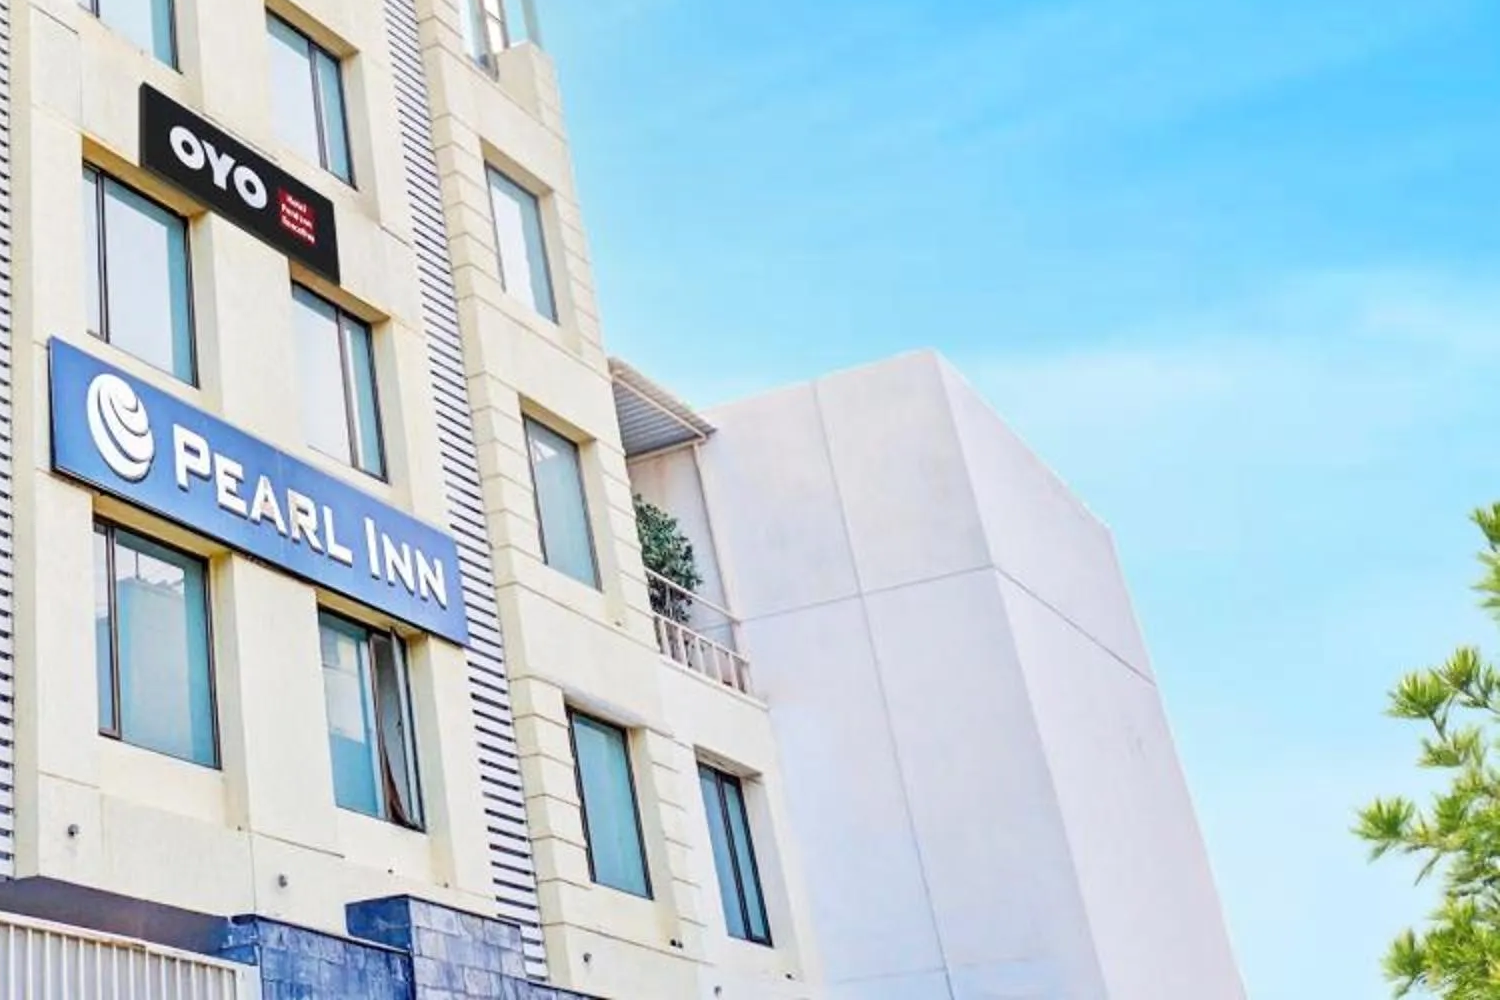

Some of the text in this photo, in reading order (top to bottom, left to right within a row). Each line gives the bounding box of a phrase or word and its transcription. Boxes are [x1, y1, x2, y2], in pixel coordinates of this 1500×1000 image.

[169, 125, 268, 209] OYO
[172, 424, 447, 609] PEARL INN
